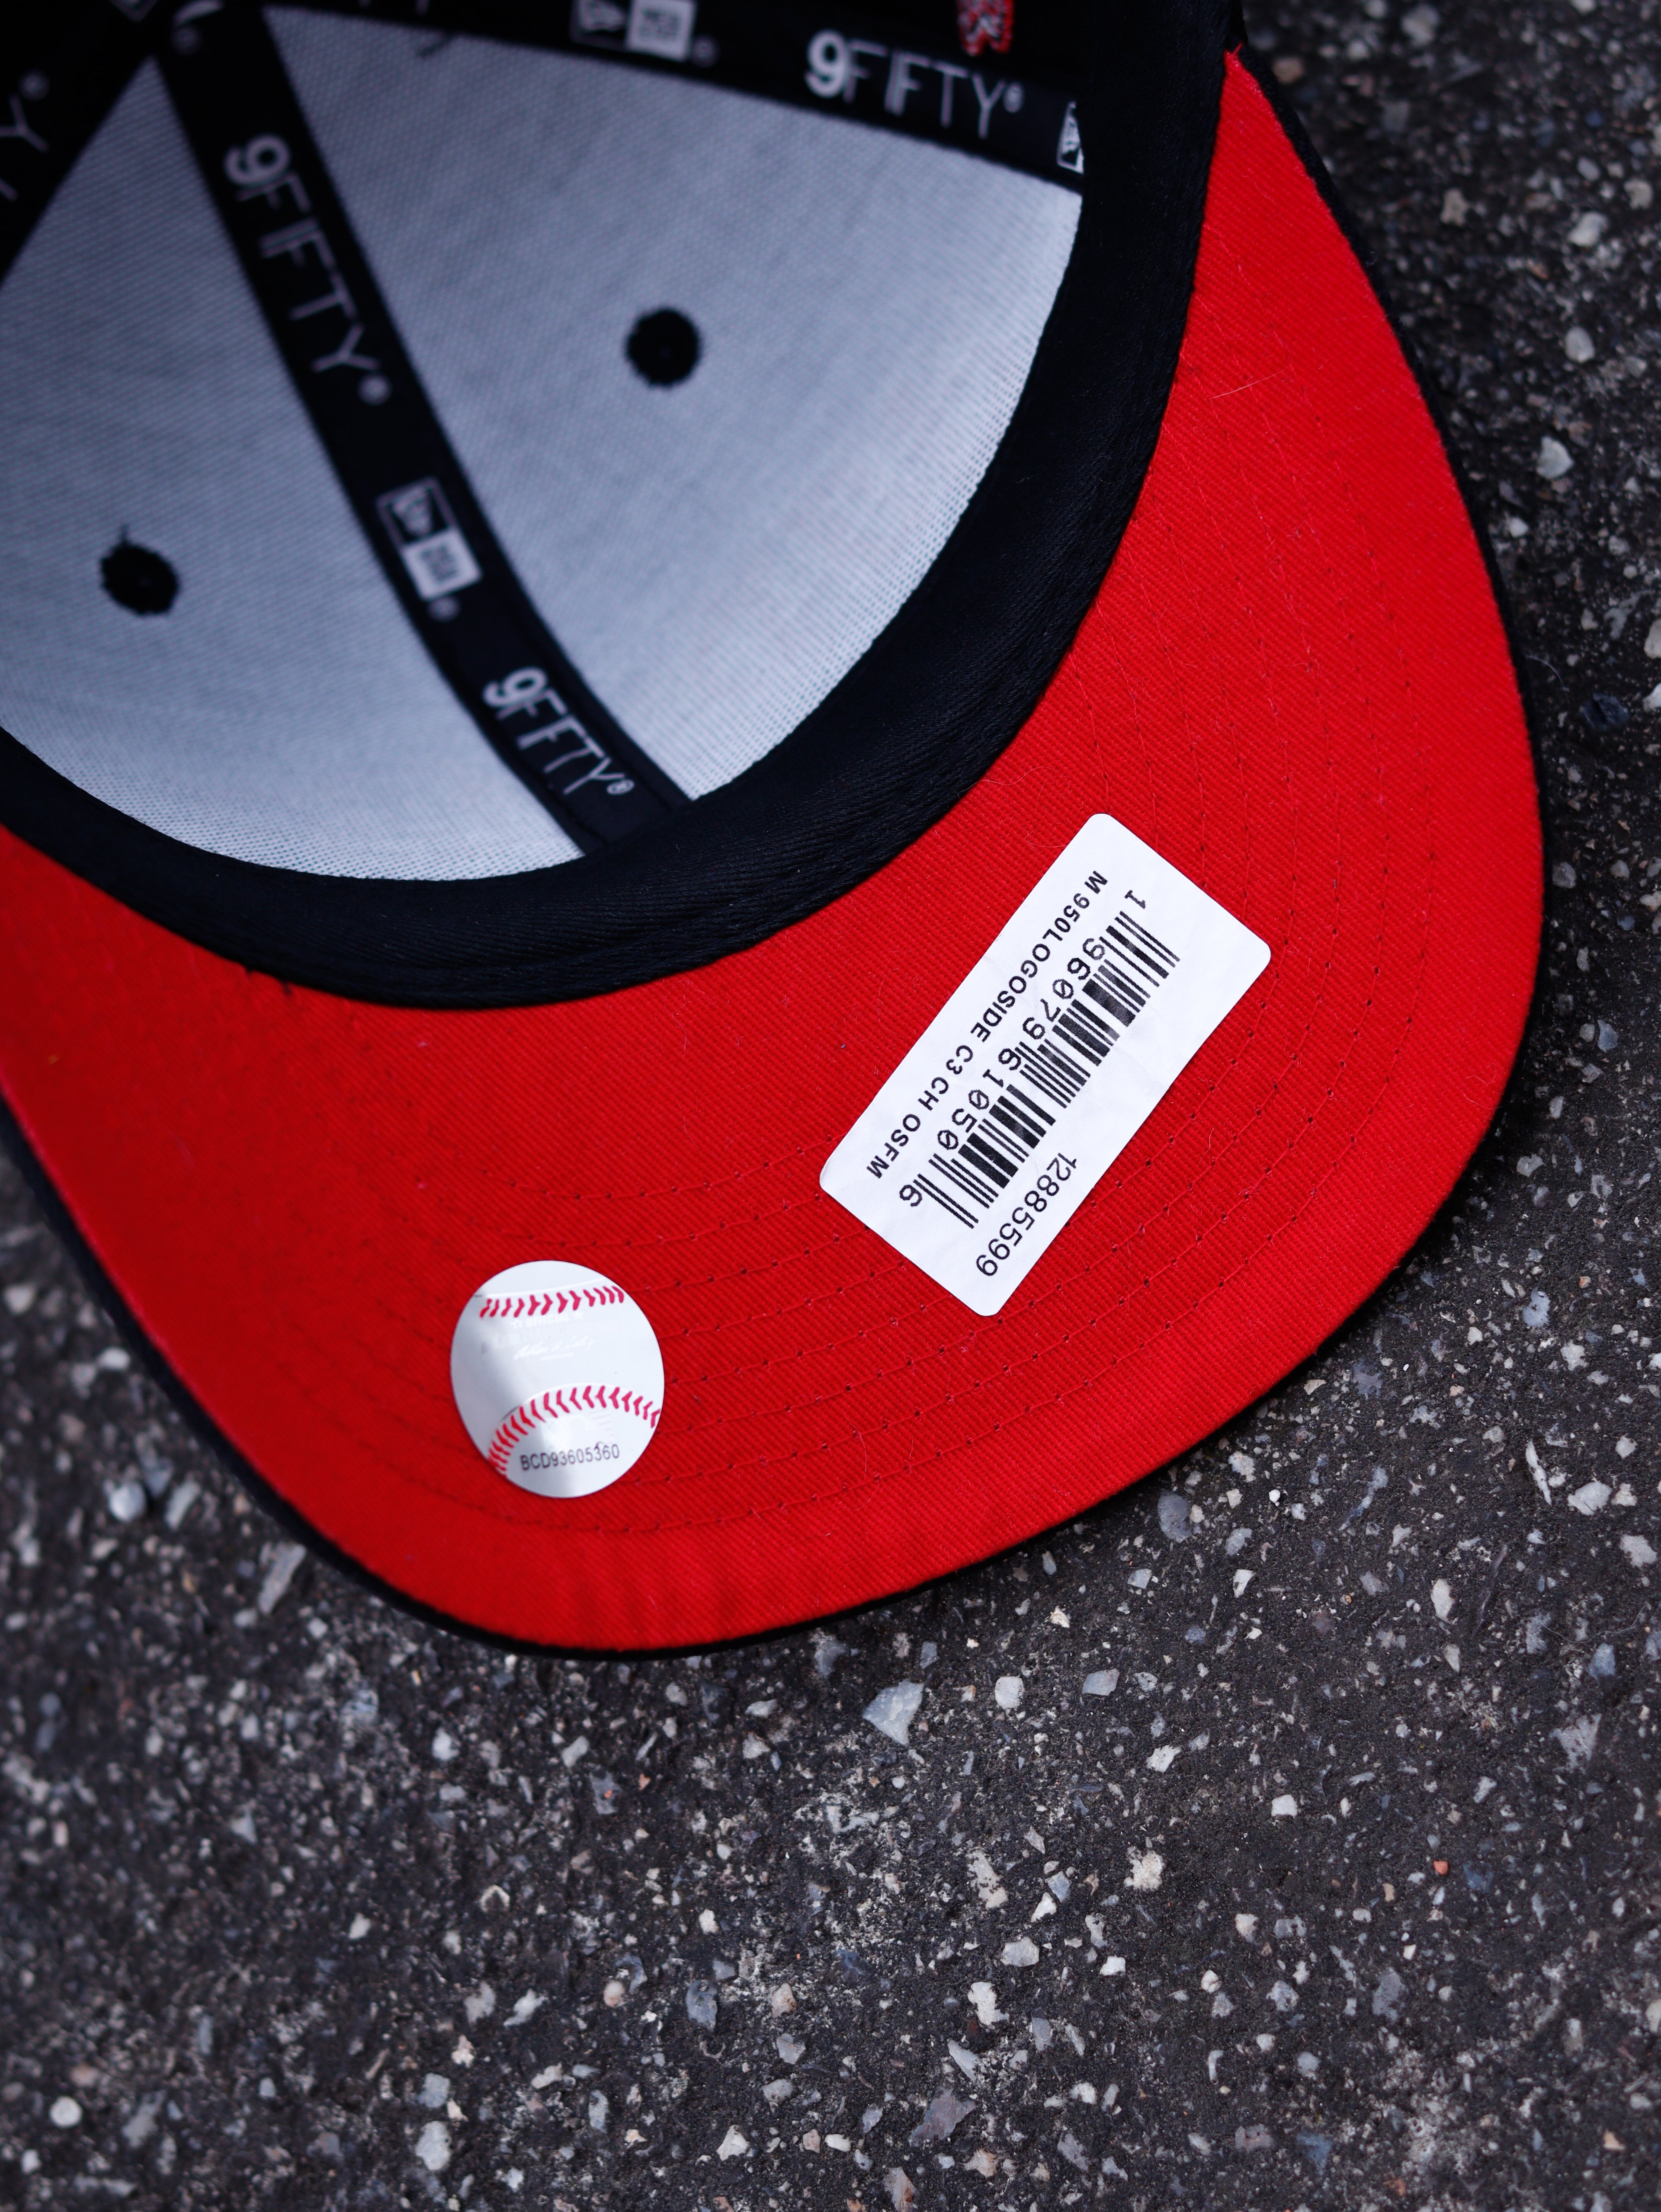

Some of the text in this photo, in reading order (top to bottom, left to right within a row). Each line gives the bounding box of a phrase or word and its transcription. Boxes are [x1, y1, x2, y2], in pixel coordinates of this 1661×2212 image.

[1124, 890, 1146, 910] 1
[866, 870, 1108, 1178] M 950LOGOSIDE C3 CH OSFM
[899, 1184, 923, 1207] 6
[976, 1152, 1077, 1276] 12885599
[520, 1444, 620, 1471] BCD93605360
